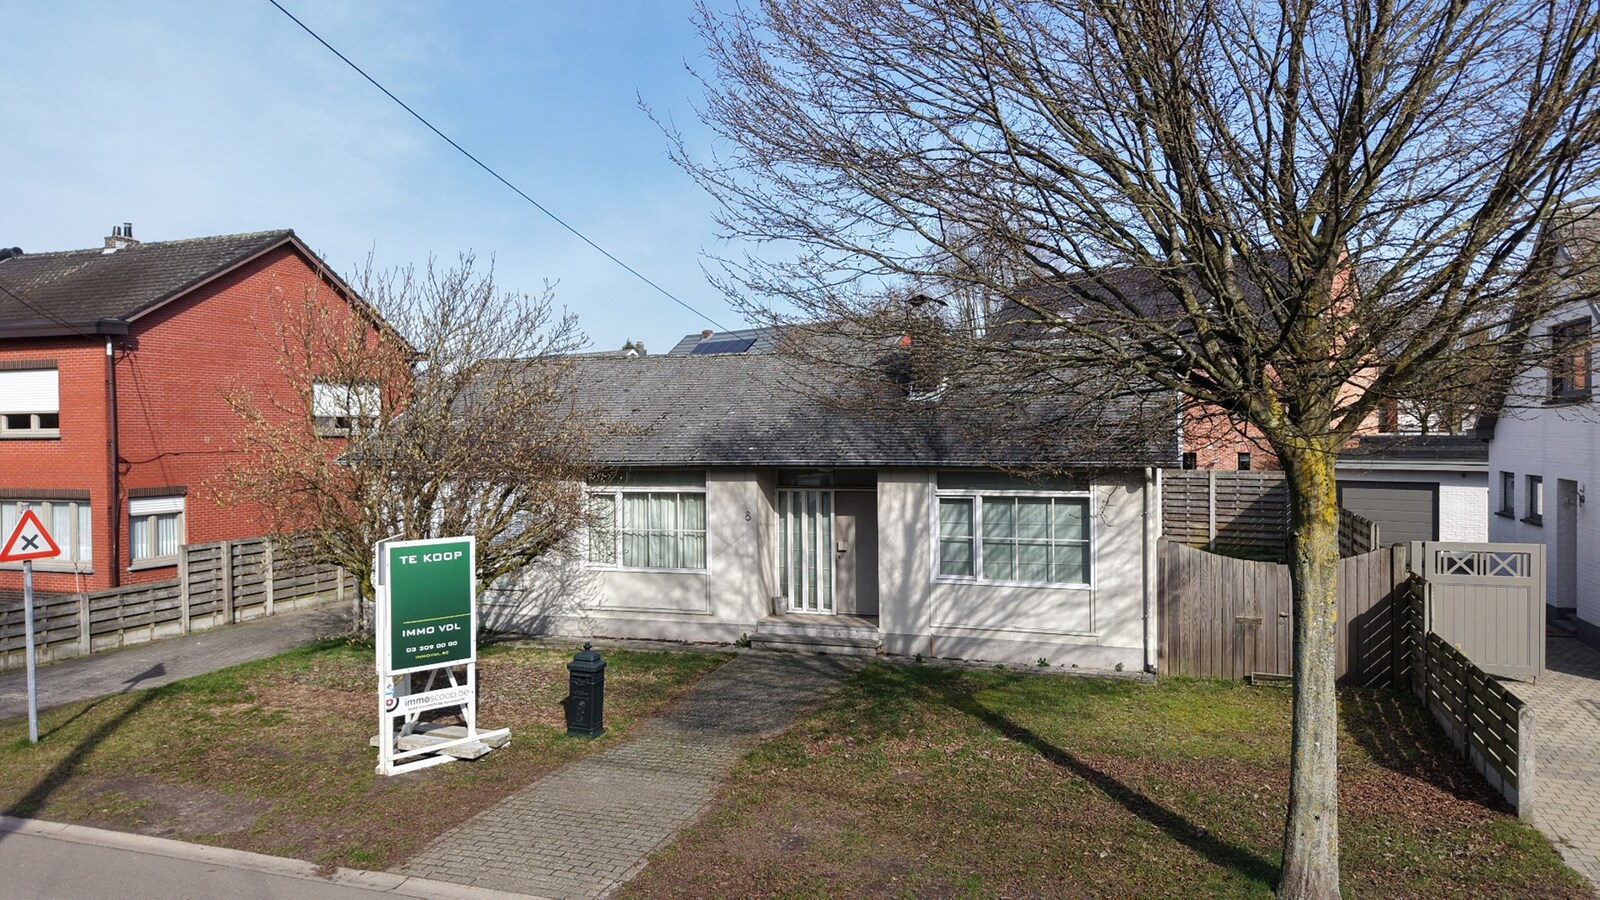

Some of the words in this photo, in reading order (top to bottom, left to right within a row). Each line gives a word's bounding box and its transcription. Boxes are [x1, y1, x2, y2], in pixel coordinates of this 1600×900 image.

[399, 555, 418, 565] TE
[423, 551, 463, 563] KOOP
[402, 625, 435, 638] IMMO
[438, 622, 461, 633] VDL
[404, 689, 470, 707] immoscoop.be
